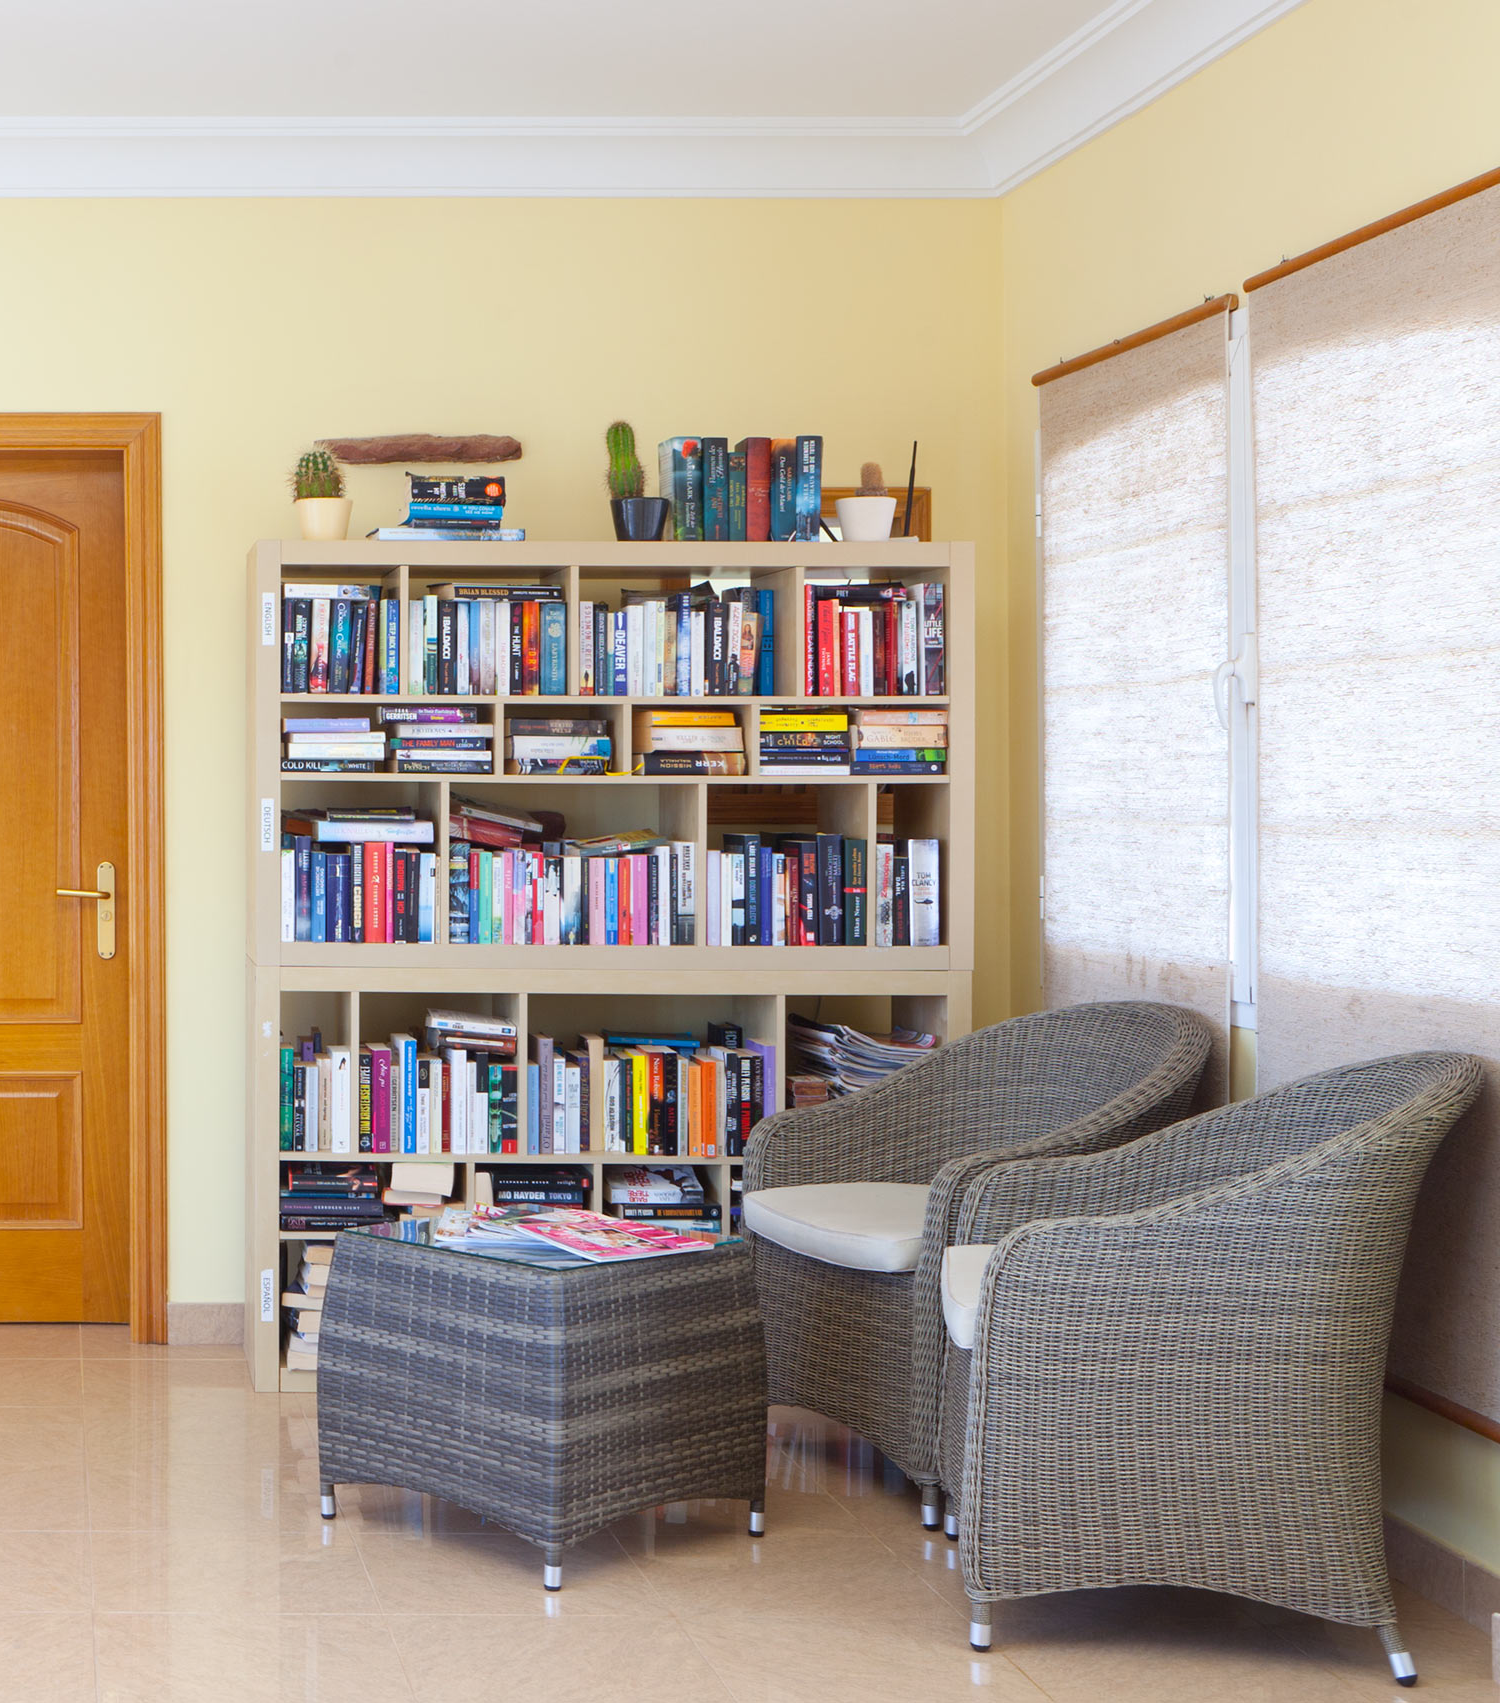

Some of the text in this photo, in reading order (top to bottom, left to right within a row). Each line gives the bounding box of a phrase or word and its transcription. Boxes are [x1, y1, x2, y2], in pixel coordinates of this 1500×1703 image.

[458, 588, 479, 596] BRIAN
[480, 588, 509, 597] BLESSED
[263, 602, 273, 636] ENGLISH
[389, 621, 398, 635] STEP
[732, 606, 740, 628] AGENT
[442, 620, 451, 660] BALDACCI
[713, 620, 722, 661] BALDACCI
[923, 627, 944, 638] LIFE
[511, 635, 522, 657] HUNT
[615, 633, 627, 670] DEAVER
[807, 630, 815, 682] FEAR INDEX
[847, 632, 855, 682] BATTLE FLAG
[527, 650, 537, 672] DRY
[550, 642, 559, 682] LABYRINTH
[401, 738, 457, 747] THE FAMILY MAN
[777, 739, 809, 747] CHILD
[782, 733, 803, 741] LEE
[281, 760, 322, 770] COLD KILL
[347, 762, 367, 770] WHITE
[694, 759, 726, 769] KERR
[263, 806, 273, 844] DEUTSCH
[911, 879, 937, 887] CLANCY
[915, 872, 932, 880] TOM
[352, 885, 362, 929] CONGO
[397, 901, 405, 914] ICH
[853, 895, 861, 938] Håkan Nesser
[652, 1057, 661, 1100] Nora Roberts
[359, 1084, 372, 1120] KRISTENSEN
[359, 1121, 372, 1135] TOM
[542, 1114, 551, 1149] O'Farrell
[556, 1179, 576, 1187] twilight
[498, 1190, 572, 1201] MO HAYDER TOKYO
[262, 1277, 273, 1313] ESPAÑOL
